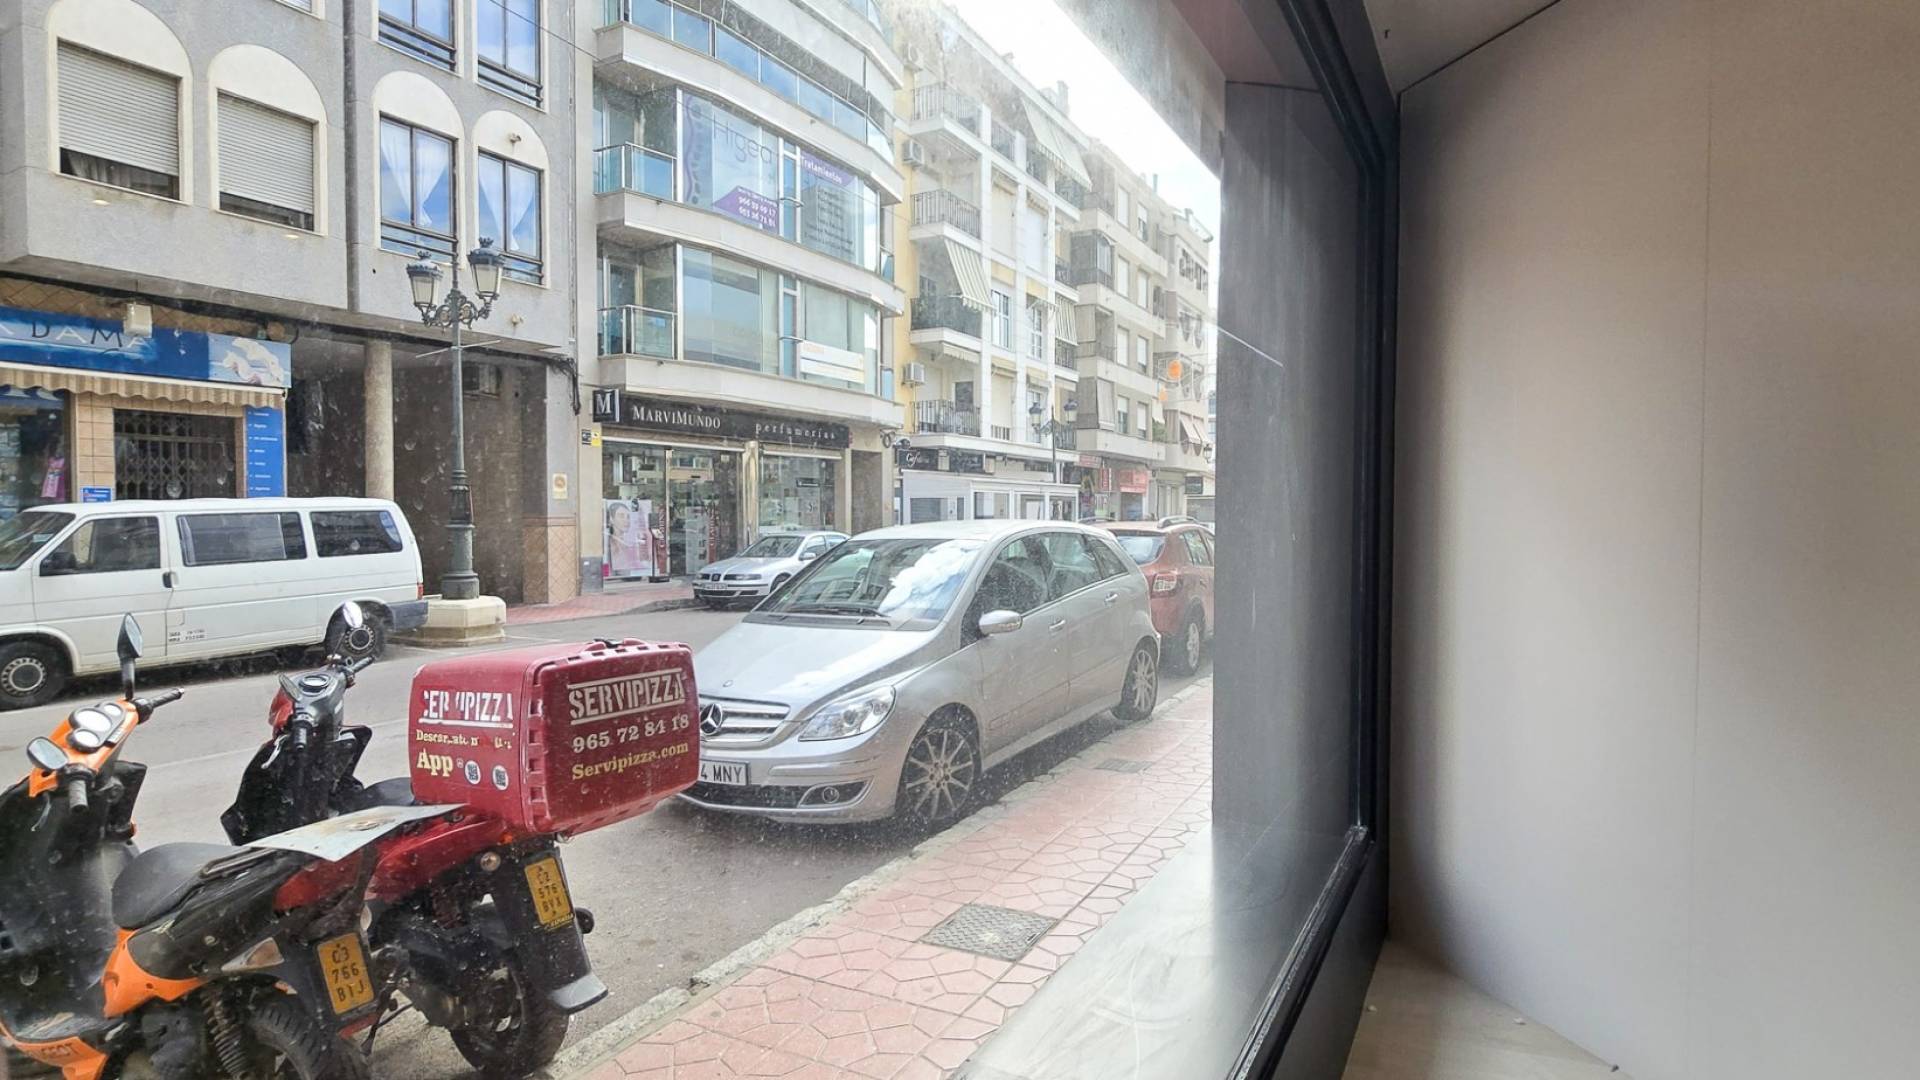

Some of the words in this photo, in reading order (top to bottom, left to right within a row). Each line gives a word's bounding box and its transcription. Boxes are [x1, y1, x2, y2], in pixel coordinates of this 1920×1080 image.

[597, 391, 612, 415] M
[568, 673, 686, 720] SERVIPIZZA
[572, 731, 610, 754] 965
[617, 726, 640, 743] 72
[644, 719, 667, 738] 84
[671, 714, 690, 730] 18
[417, 747, 454, 777] App
[571, 742, 689, 780] Servipizza.com
[713, 764, 743, 783] MNY
